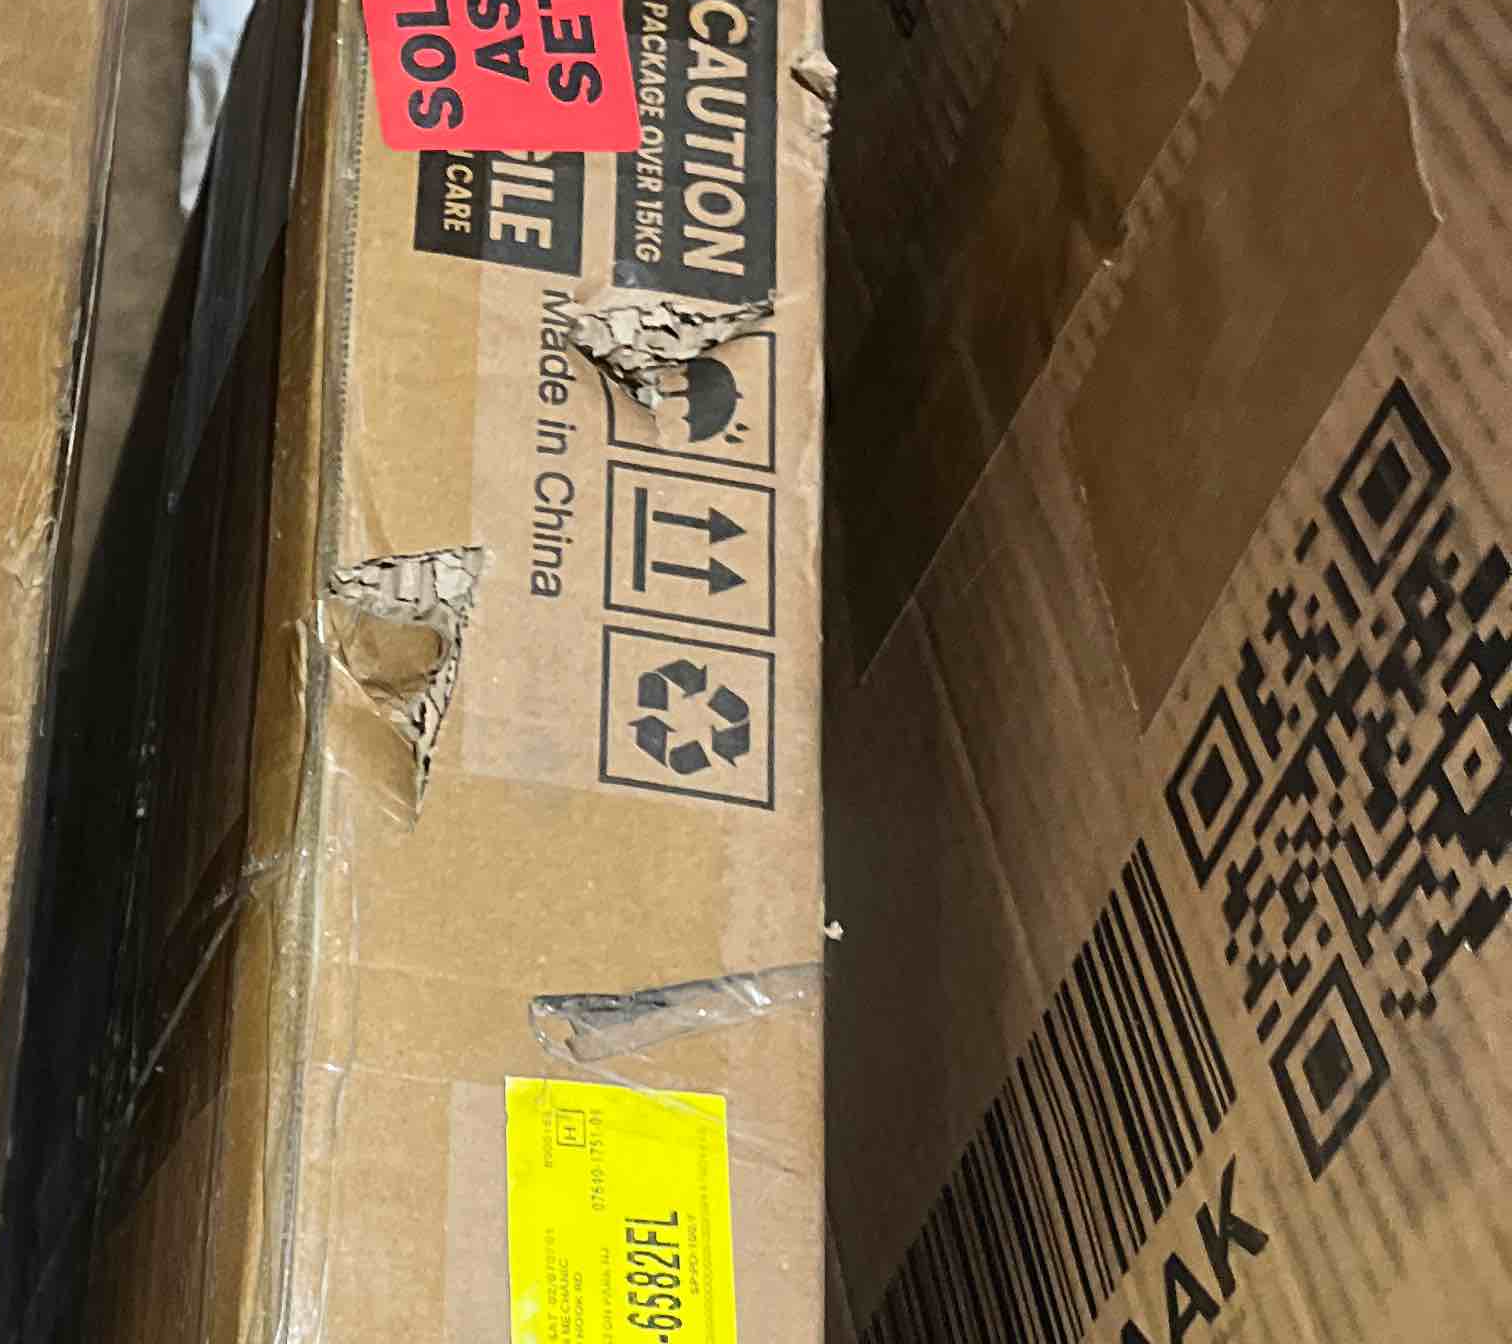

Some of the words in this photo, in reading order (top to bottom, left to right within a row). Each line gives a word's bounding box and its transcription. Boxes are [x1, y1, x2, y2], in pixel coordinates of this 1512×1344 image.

[638, 1, 668, 119] PACKAGE
[636, 125, 665, 192] OVER
[683, 0, 748, 276] CAUTION
[443, 163, 473, 234] CARE
[635, 200, 664, 263] 15KG
[538, 288, 576, 406] Made
[536, 418, 570, 456] in
[530, 470, 576, 600] China
